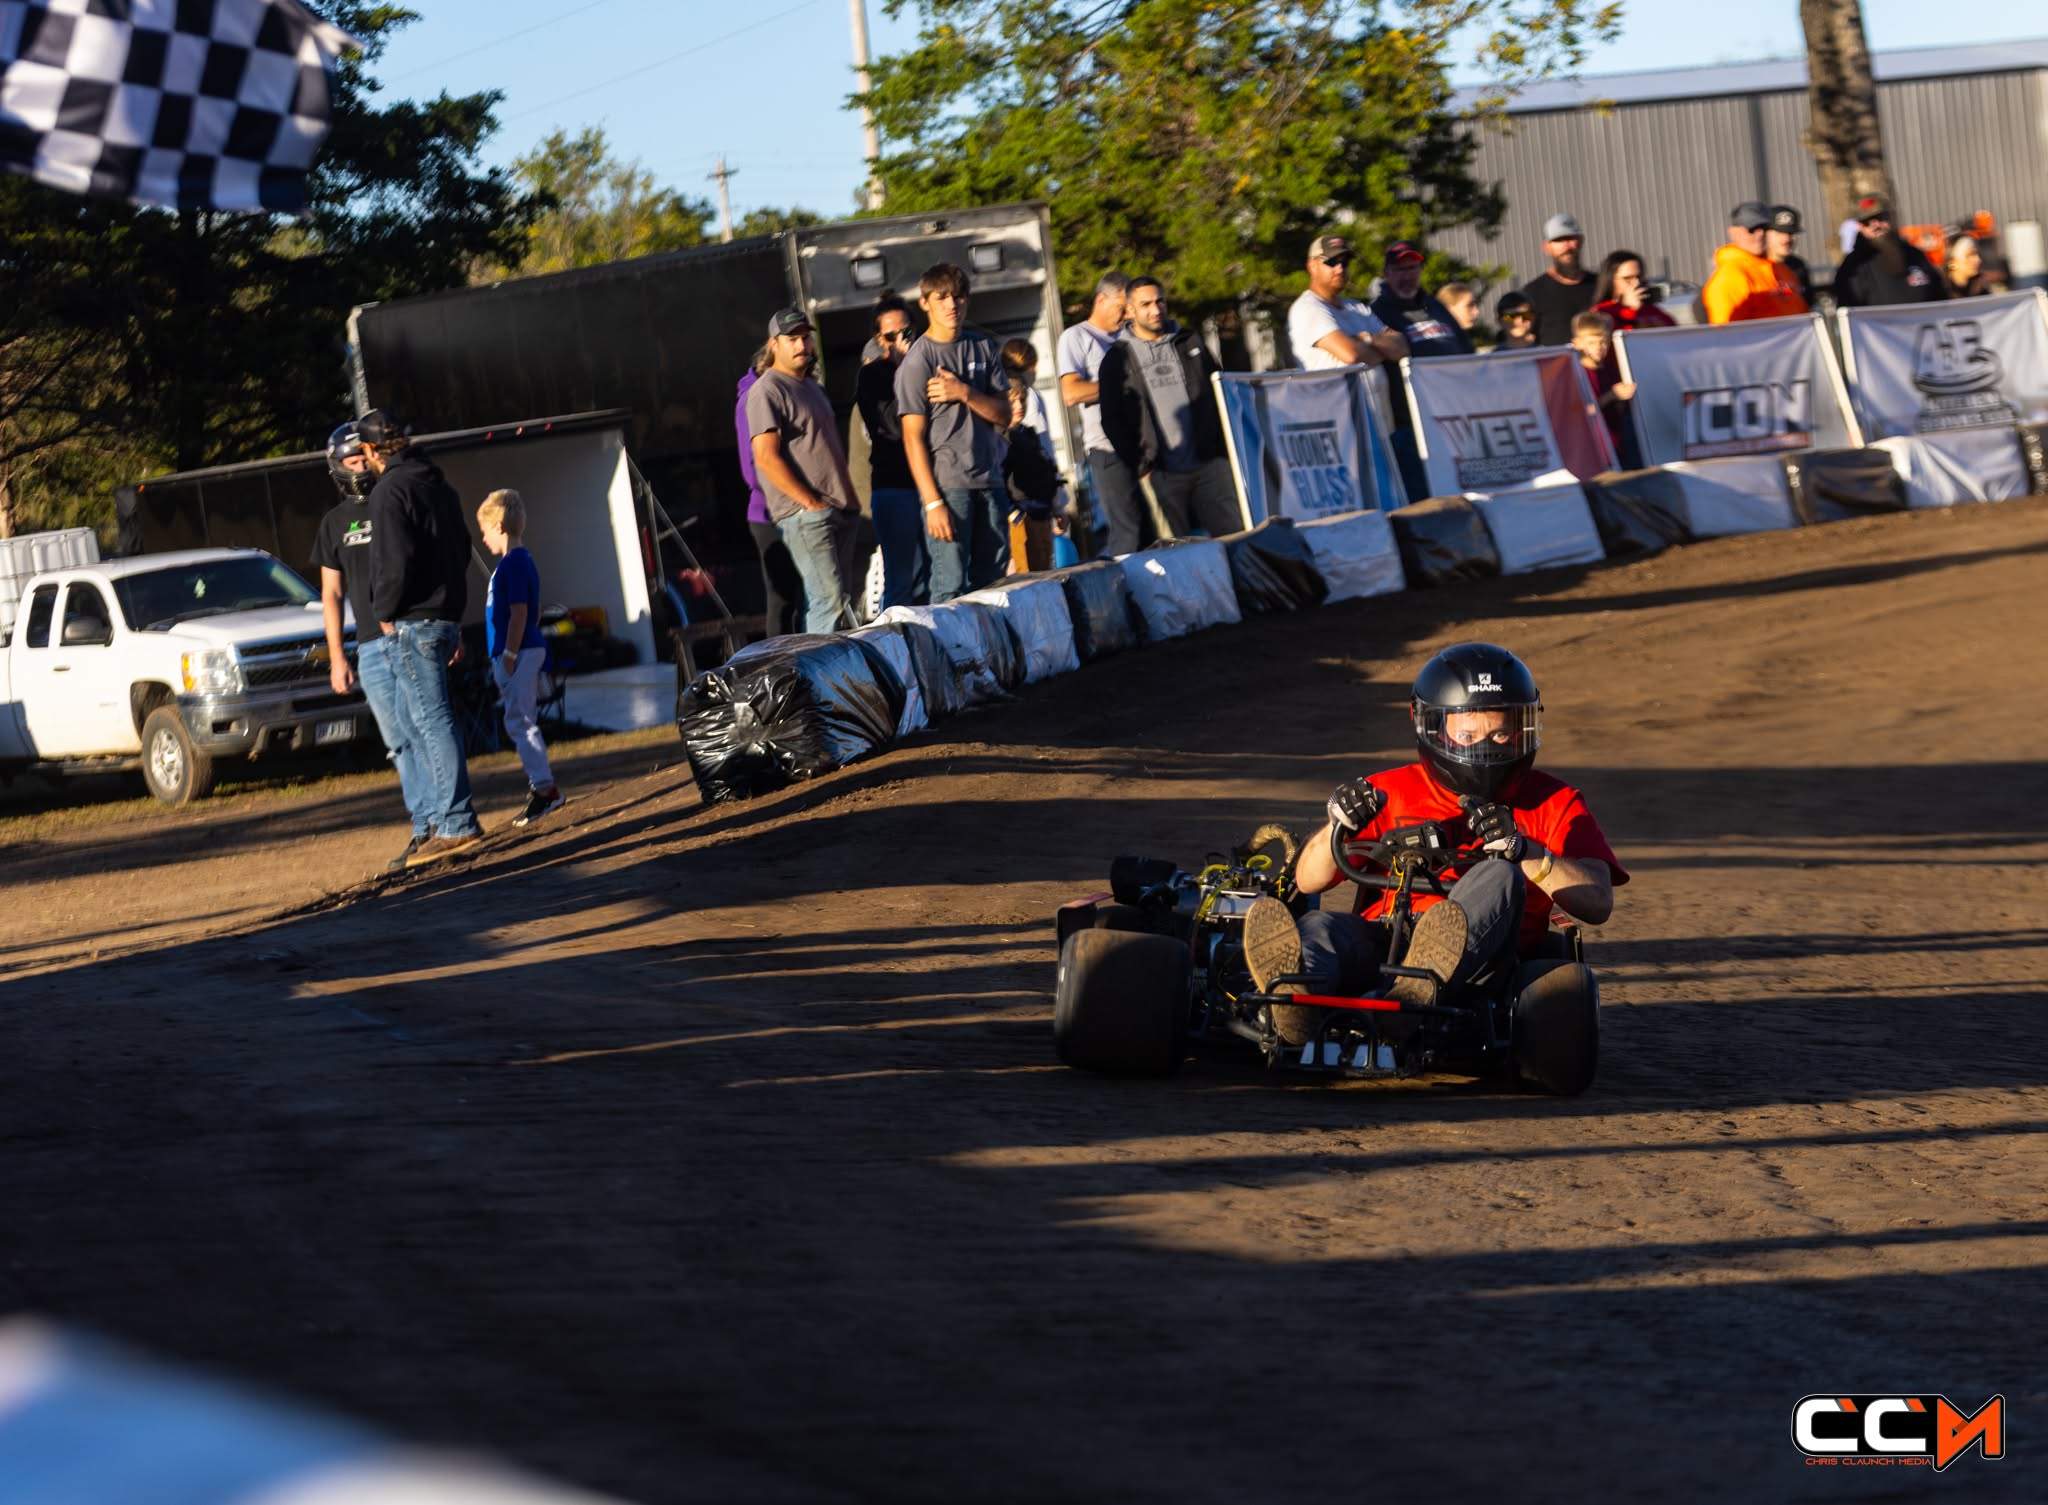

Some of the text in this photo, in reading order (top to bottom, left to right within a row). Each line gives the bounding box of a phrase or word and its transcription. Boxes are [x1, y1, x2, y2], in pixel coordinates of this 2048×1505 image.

[1684, 381, 1811, 443] ICON
[1279, 430, 1343, 468] LOONEY
[1290, 465, 1355, 509] GLASS
[1468, 684, 1502, 692] SHARK
